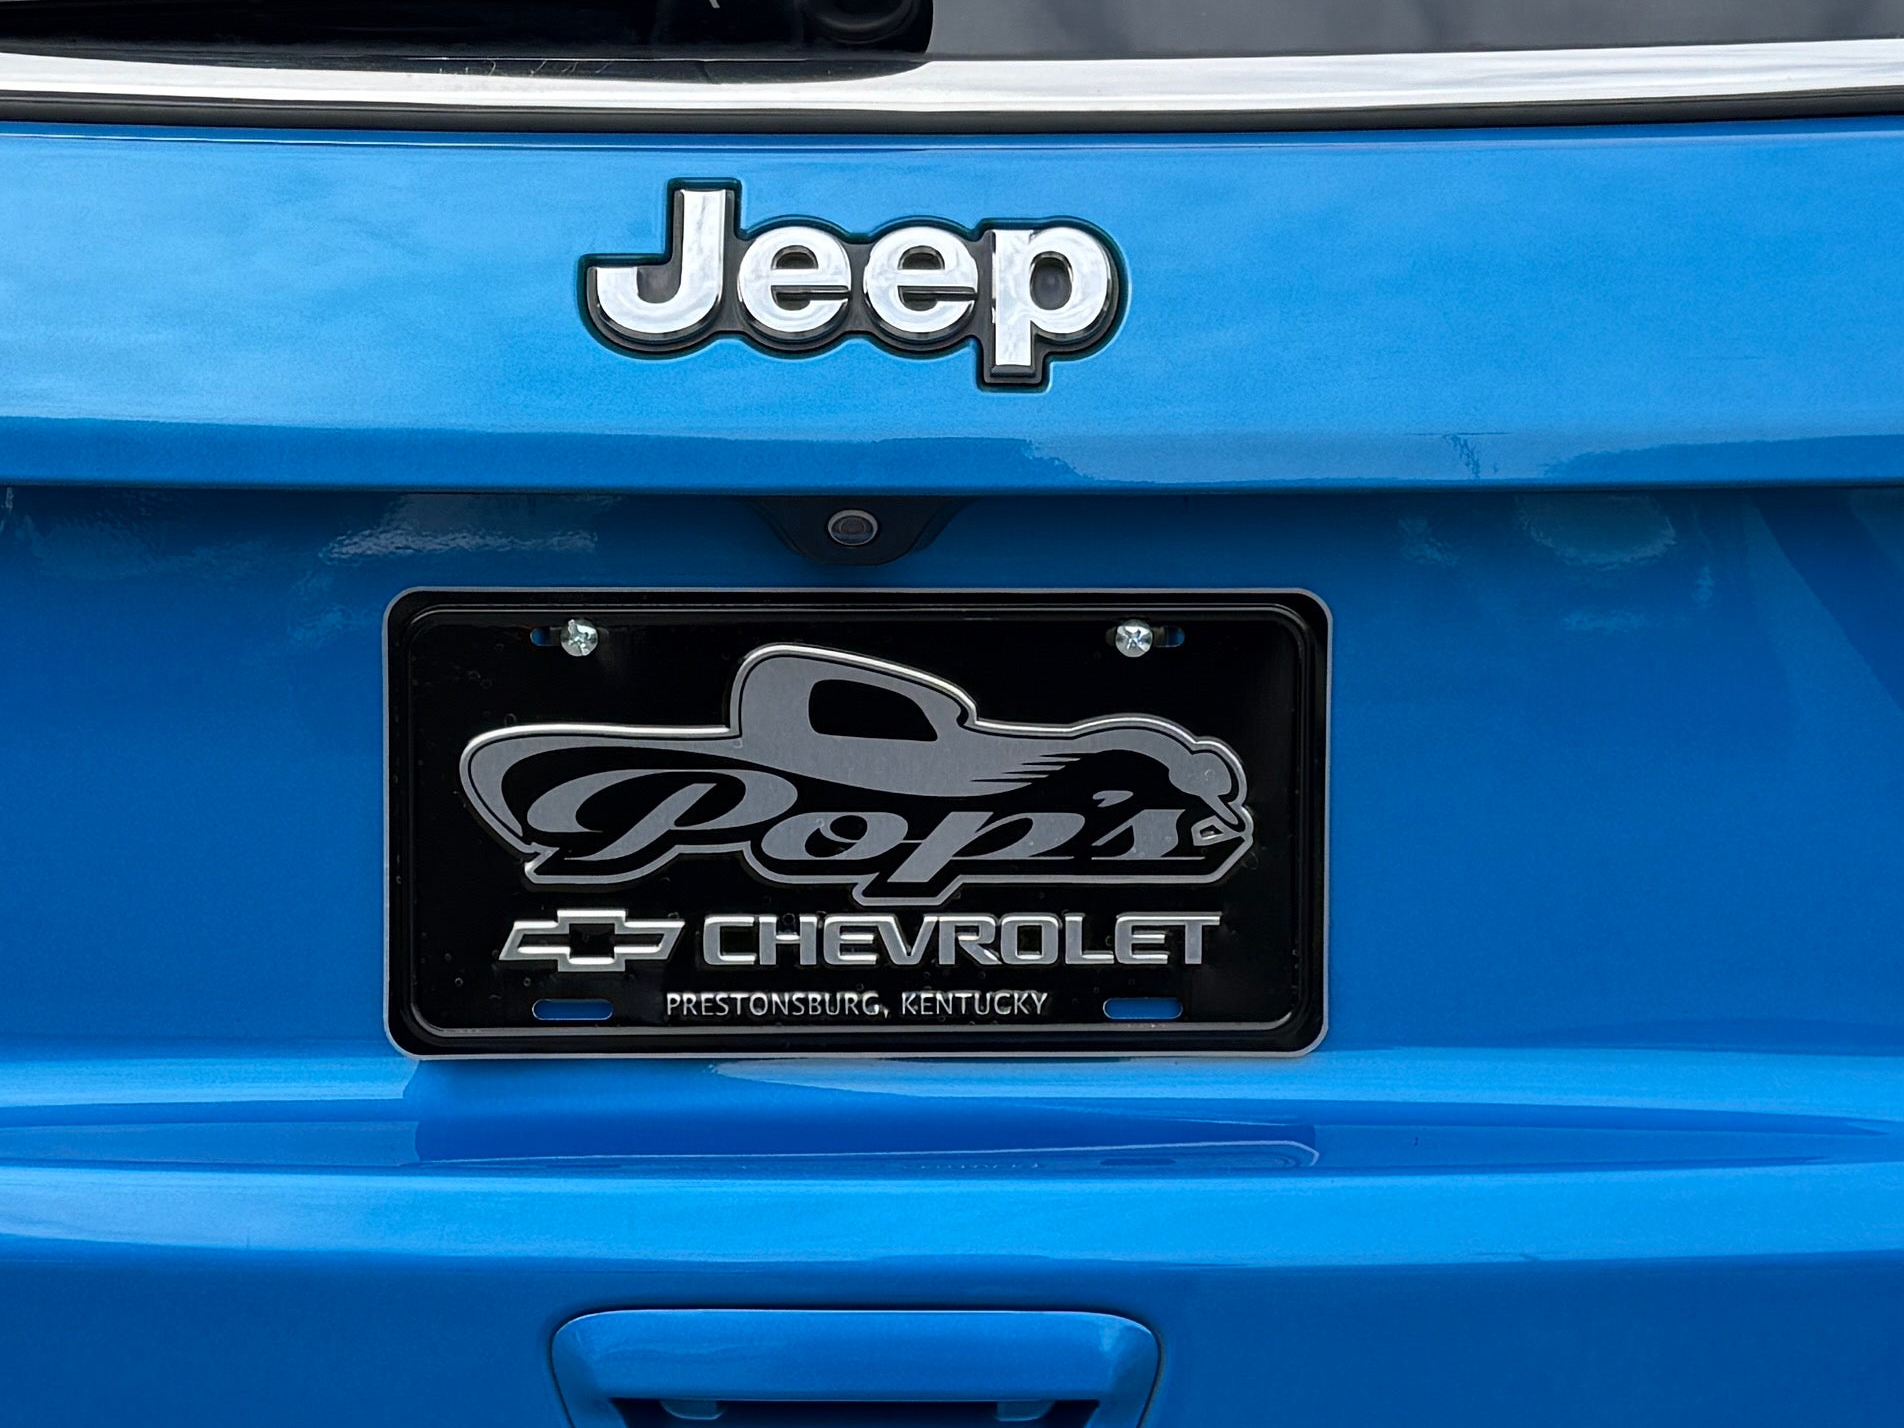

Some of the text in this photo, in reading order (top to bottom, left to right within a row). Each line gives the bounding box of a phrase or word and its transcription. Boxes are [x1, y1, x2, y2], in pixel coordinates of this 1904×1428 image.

[587, 184, 1122, 378] Jeep
[526, 769, 1208, 883] Pop's
[701, 913, 1222, 966] CHEVROLET
[665, 992, 1049, 1020] PRESTONSBURG, KENTUCKY
